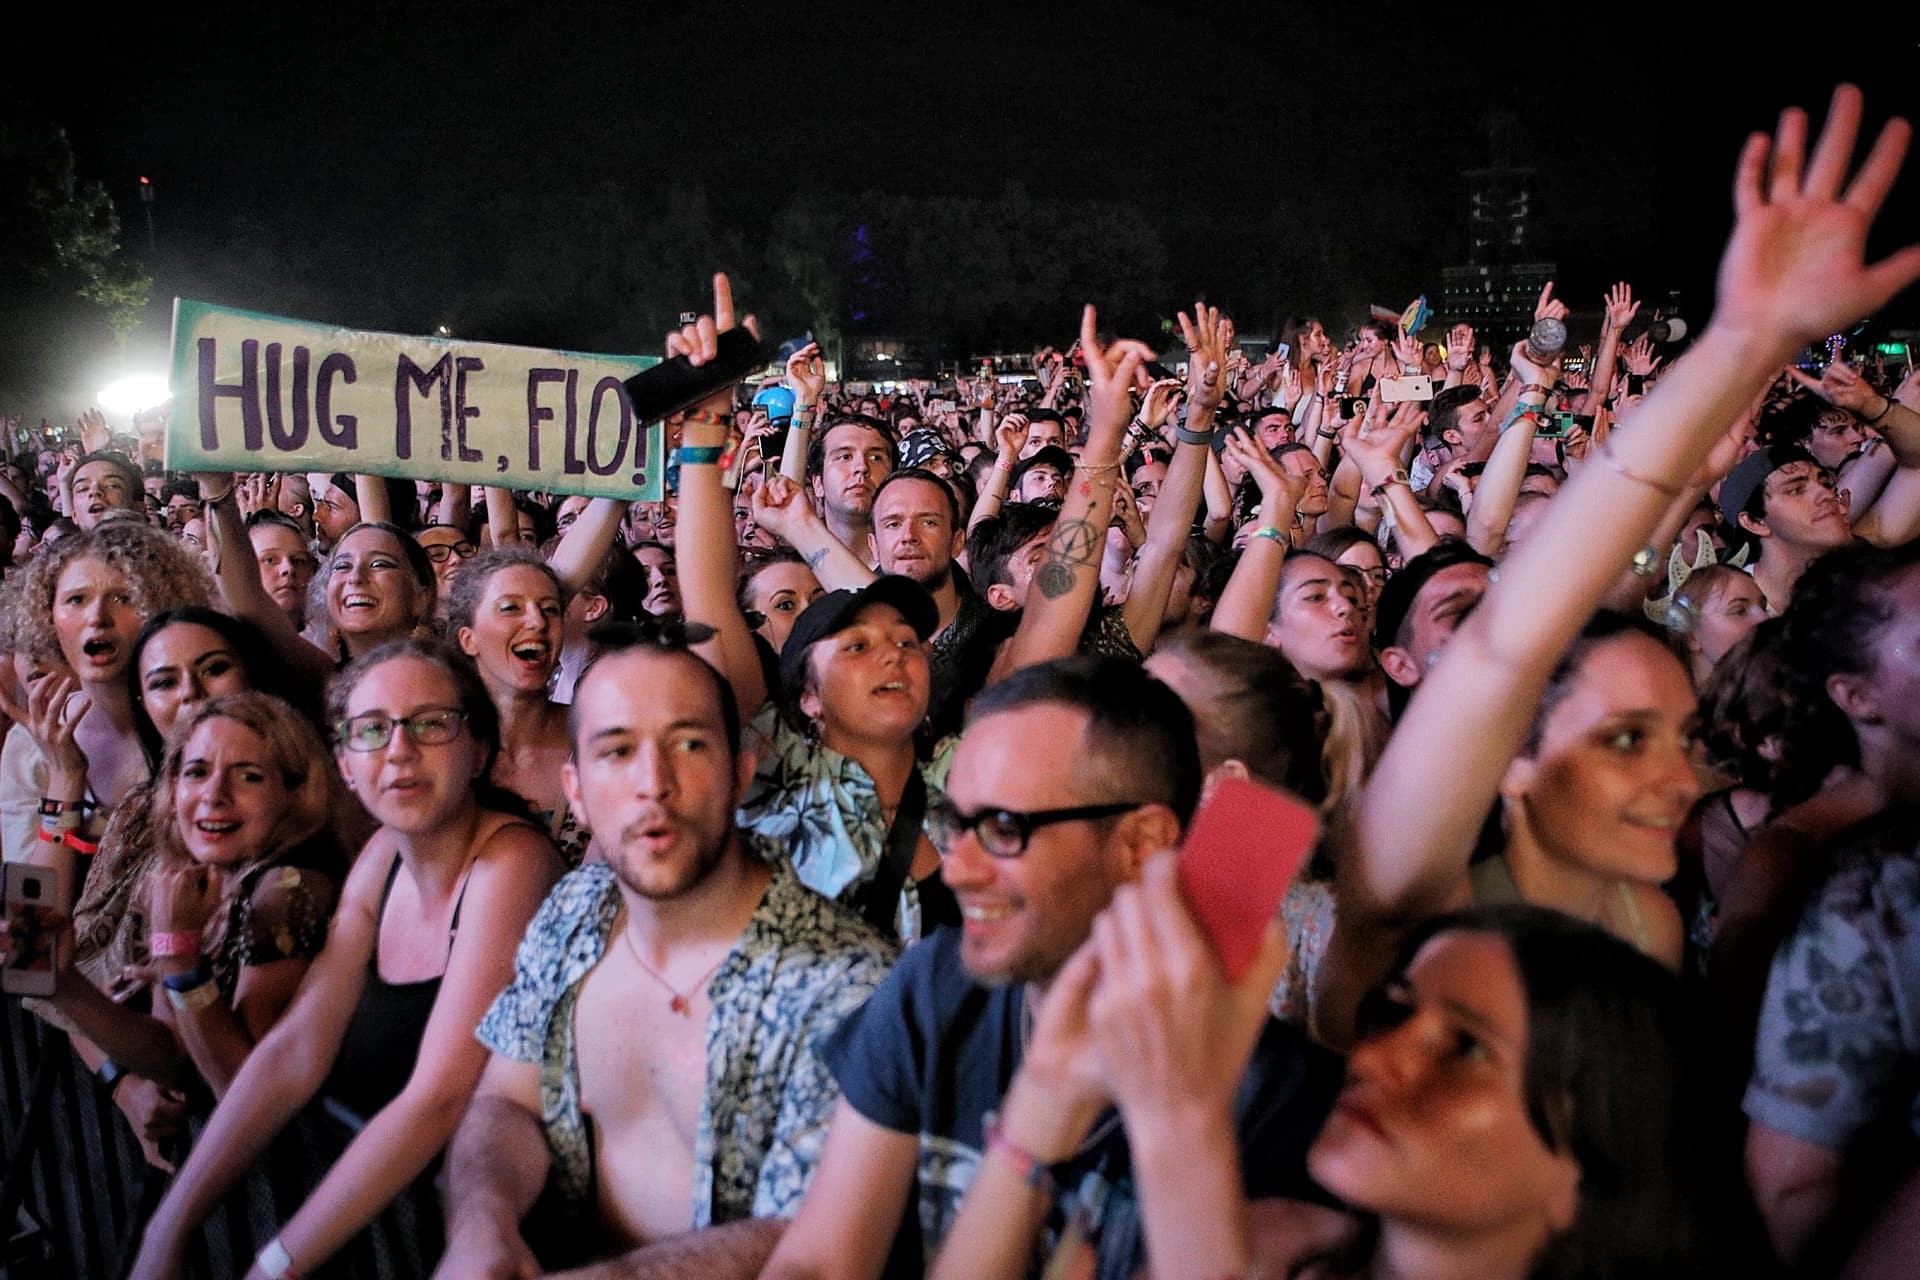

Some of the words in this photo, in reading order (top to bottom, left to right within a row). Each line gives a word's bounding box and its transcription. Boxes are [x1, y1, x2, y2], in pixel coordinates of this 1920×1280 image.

[198, 338, 358, 451] HUG
[395, 352, 509, 472] ME,
[527, 368, 647, 486] FLO!
